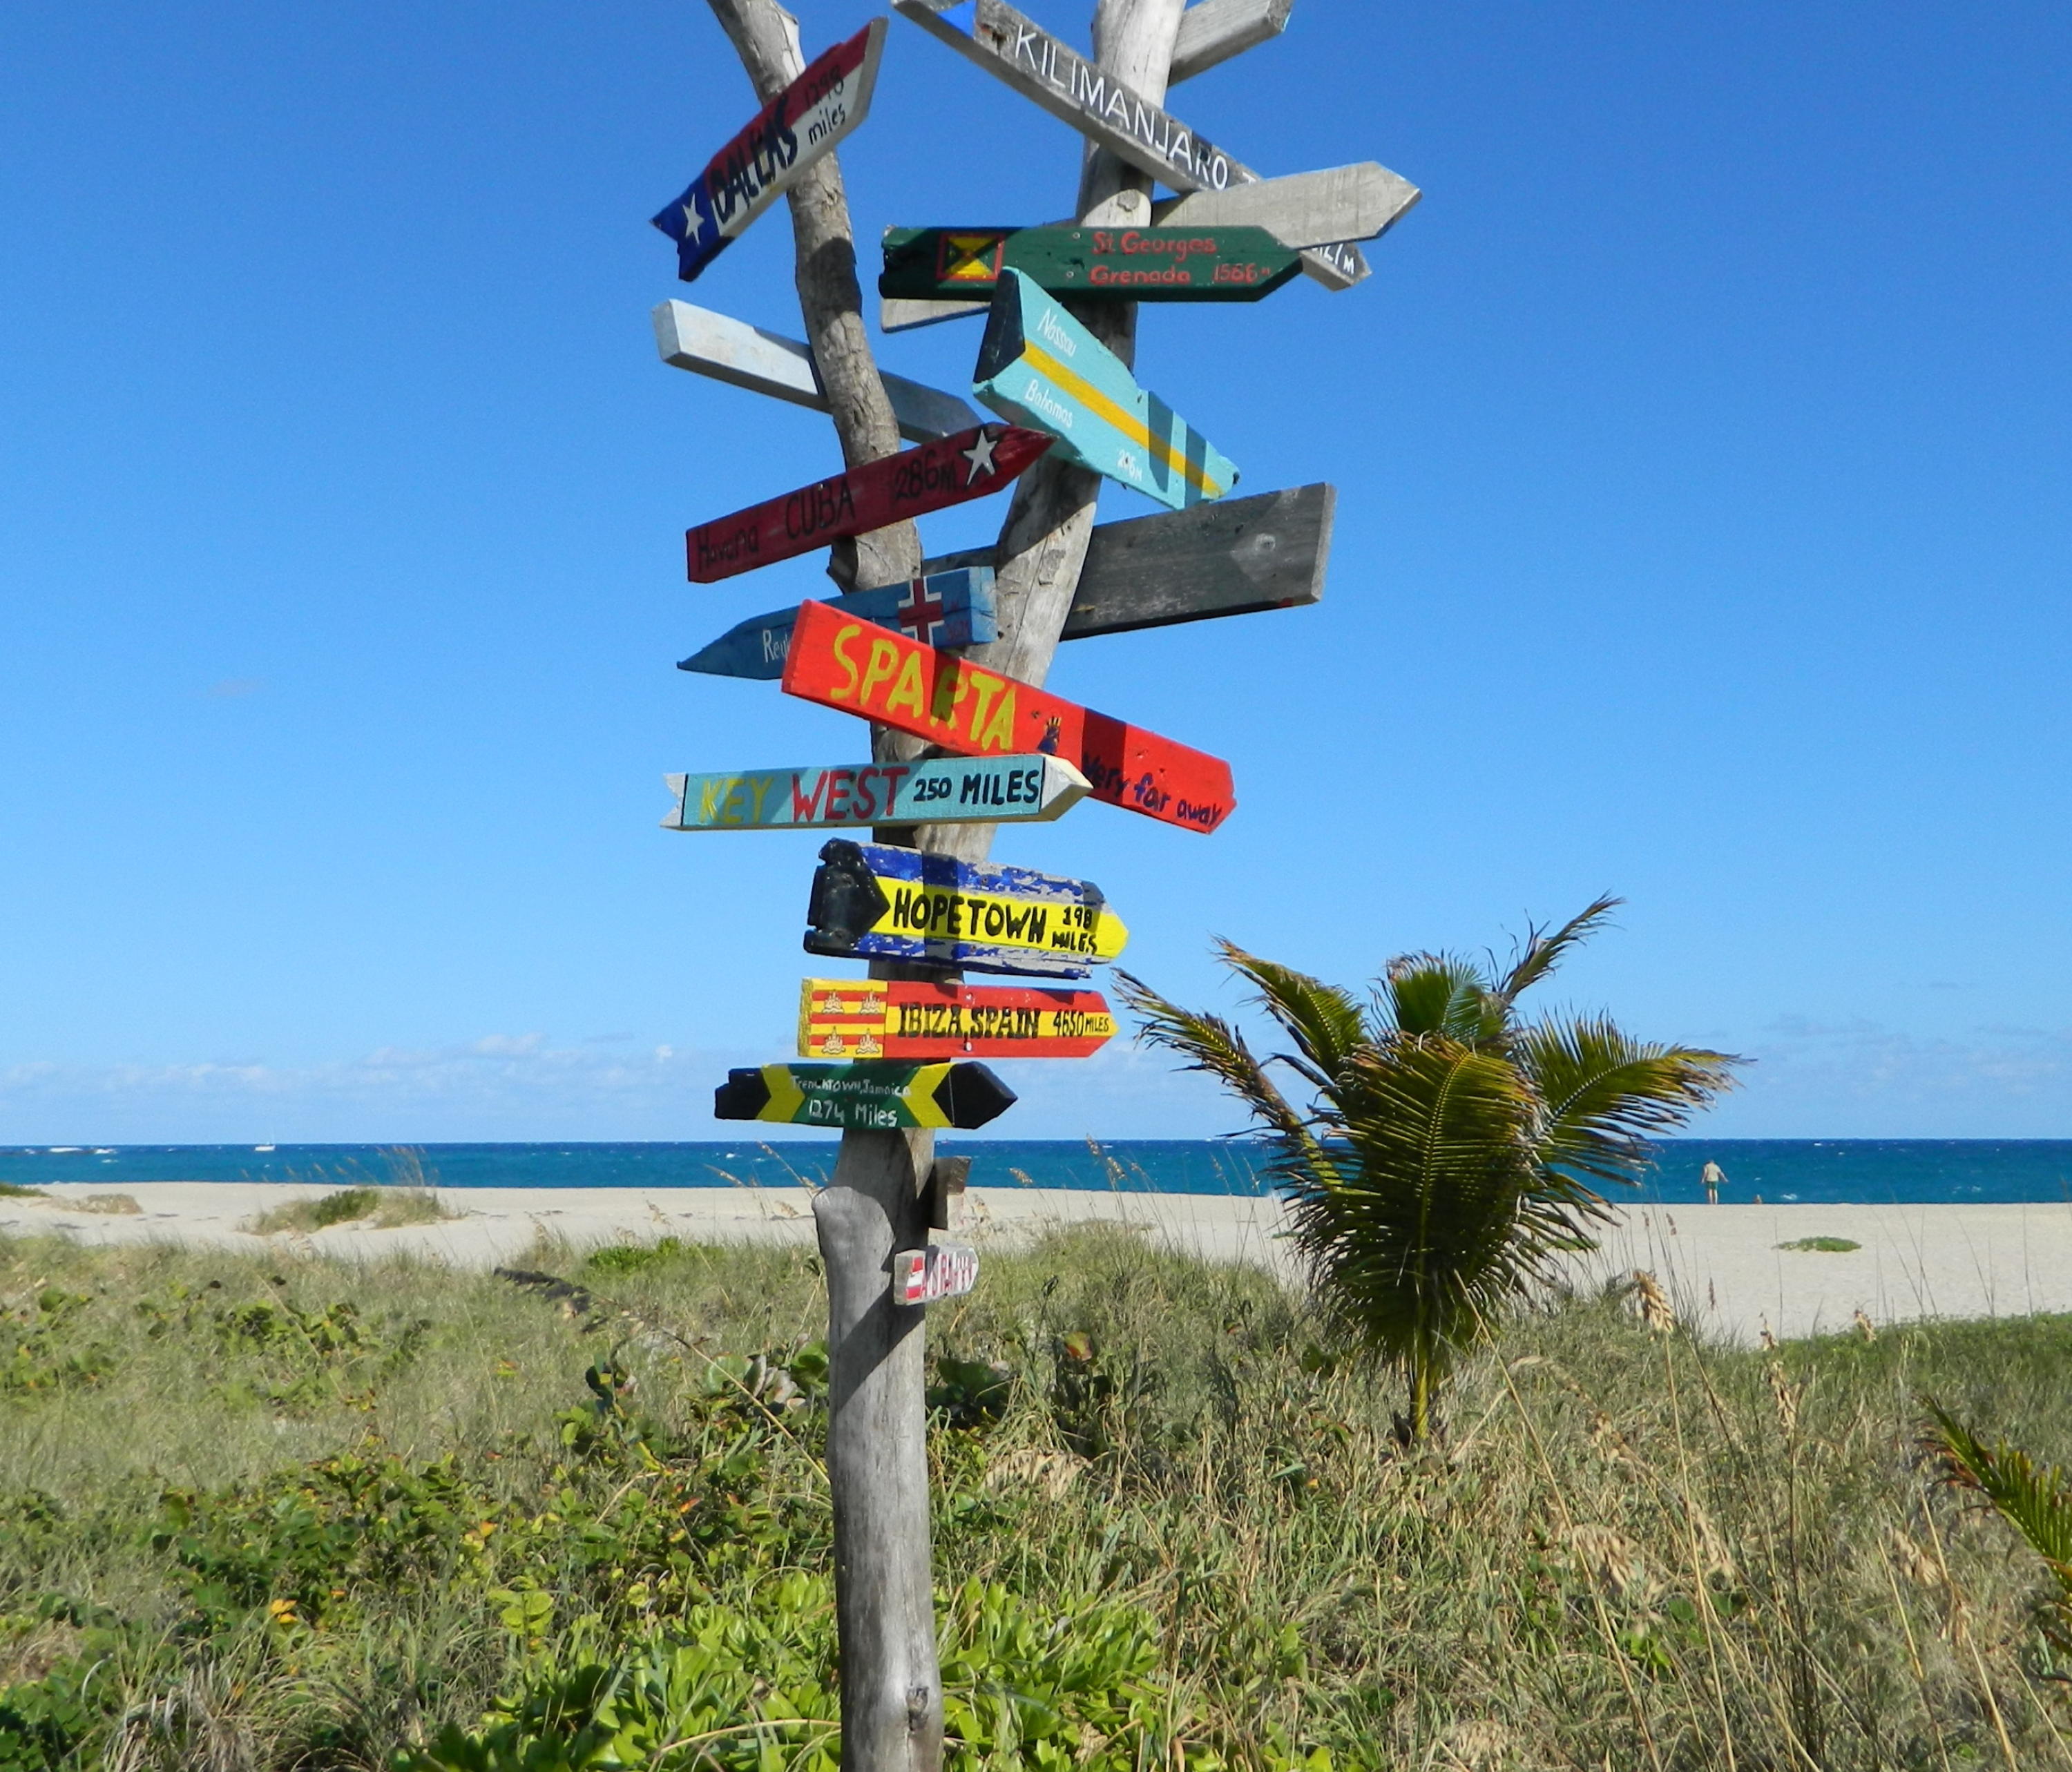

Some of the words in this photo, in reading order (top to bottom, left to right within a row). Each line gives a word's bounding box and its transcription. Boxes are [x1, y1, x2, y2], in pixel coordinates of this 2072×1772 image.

[808, 103, 845, 145] miles
[1014, 23, 1229, 191] KILIMANJARO
[711, 93, 798, 224] DALLAS
[1121, 231, 1217, 262] Georges
[1089, 265, 1191, 285] Grenada
[1037, 307, 1076, 357] Nassau
[1024, 379, 1073, 427] Bahamas
[785, 476, 856, 540] CUBA
[830, 624, 1017, 751] SPARTA
[699, 773, 773, 824] KEY
[792, 767, 910, 822] WEST
[914, 777, 952, 802] 250
[960, 769, 1040, 805] MILES
[1134, 772, 1171, 812] far
[1177, 799, 1222, 826] away
[893, 888, 1047, 943] HOPETOWN
[1062, 906, 1093, 929] 198
[1051, 931, 1097, 955] MILES
[970, 1005, 1041, 1039] SPAIN
[1053, 1009, 1084, 1037] 4650
[1085, 1017, 1109, 1032] MILES
[809, 1099, 845, 1124] 1274
[855, 1104, 898, 1127] Miles
